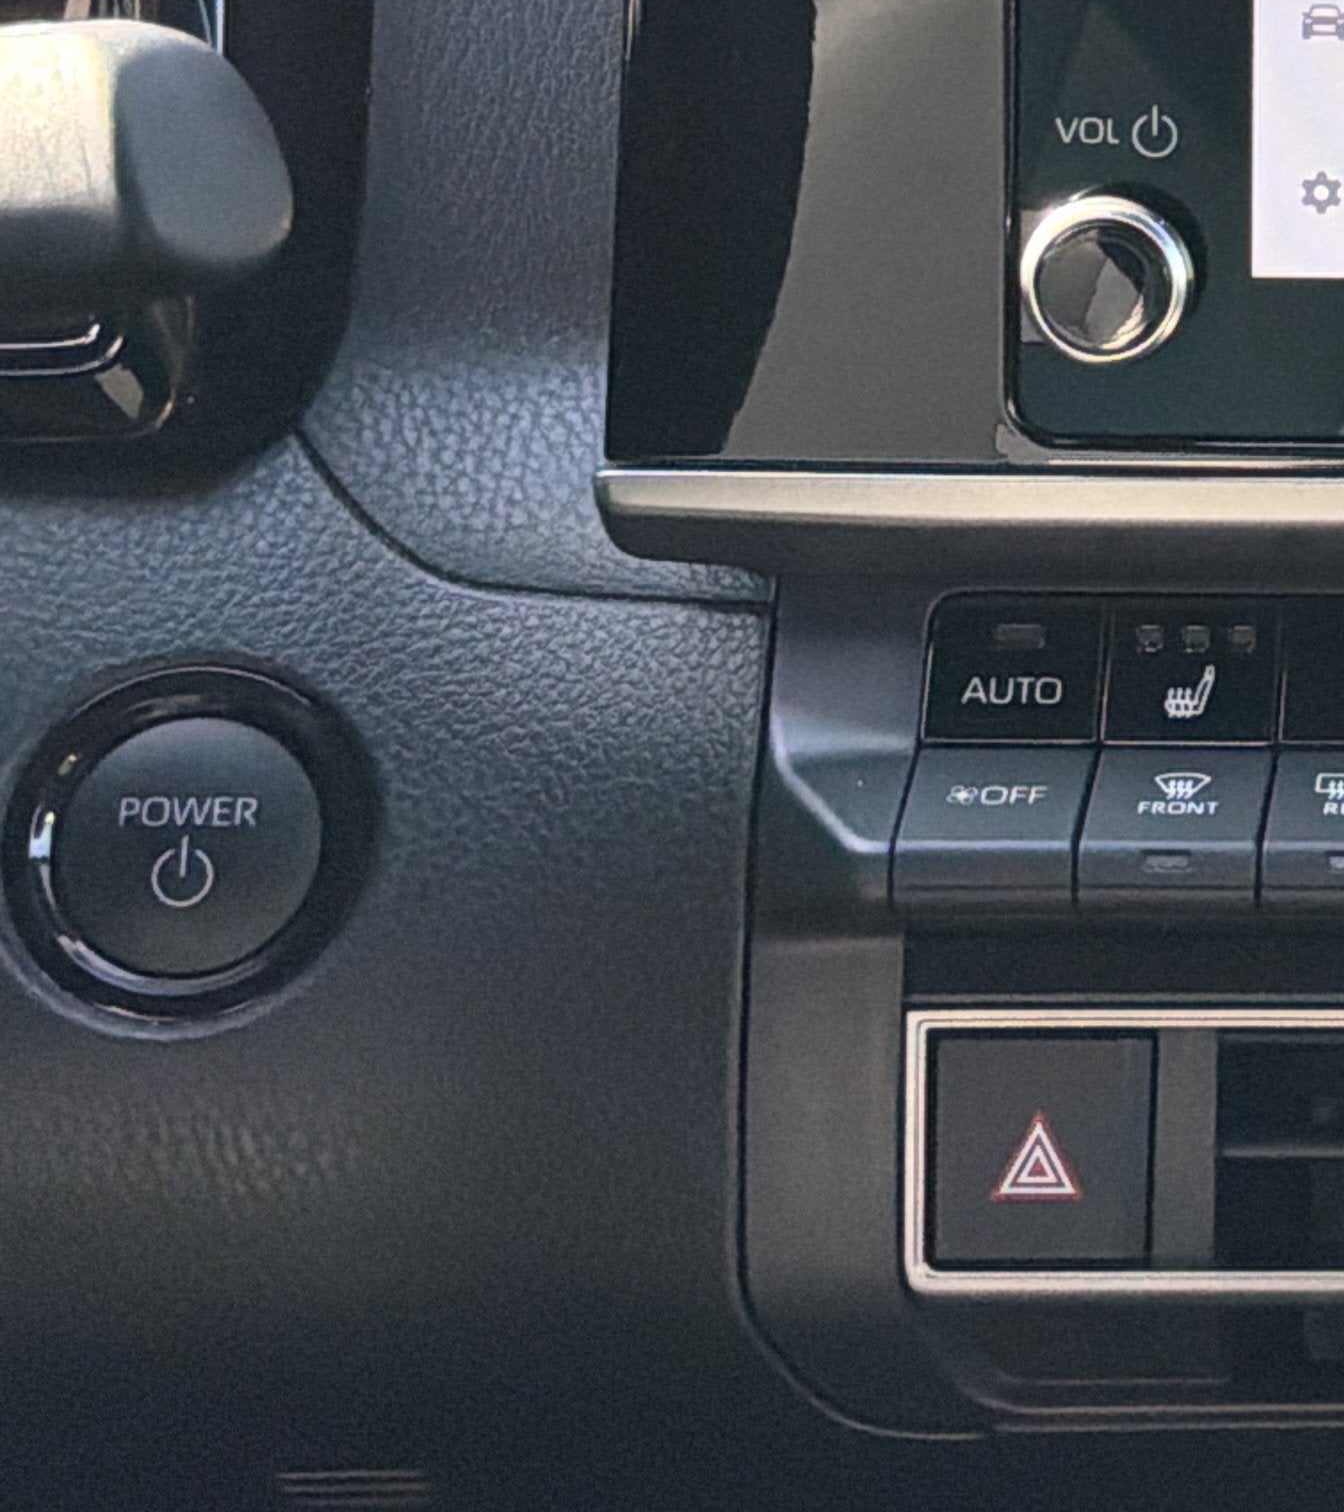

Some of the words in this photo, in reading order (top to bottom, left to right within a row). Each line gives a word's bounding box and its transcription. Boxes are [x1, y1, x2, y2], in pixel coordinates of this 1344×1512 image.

[1055, 116, 1120, 145] VOL
[961, 676, 1063, 705] AUTO
[980, 784, 1049, 806] OFF
[1137, 801, 1218, 815] FRONT
[119, 796, 258, 827] POWER
